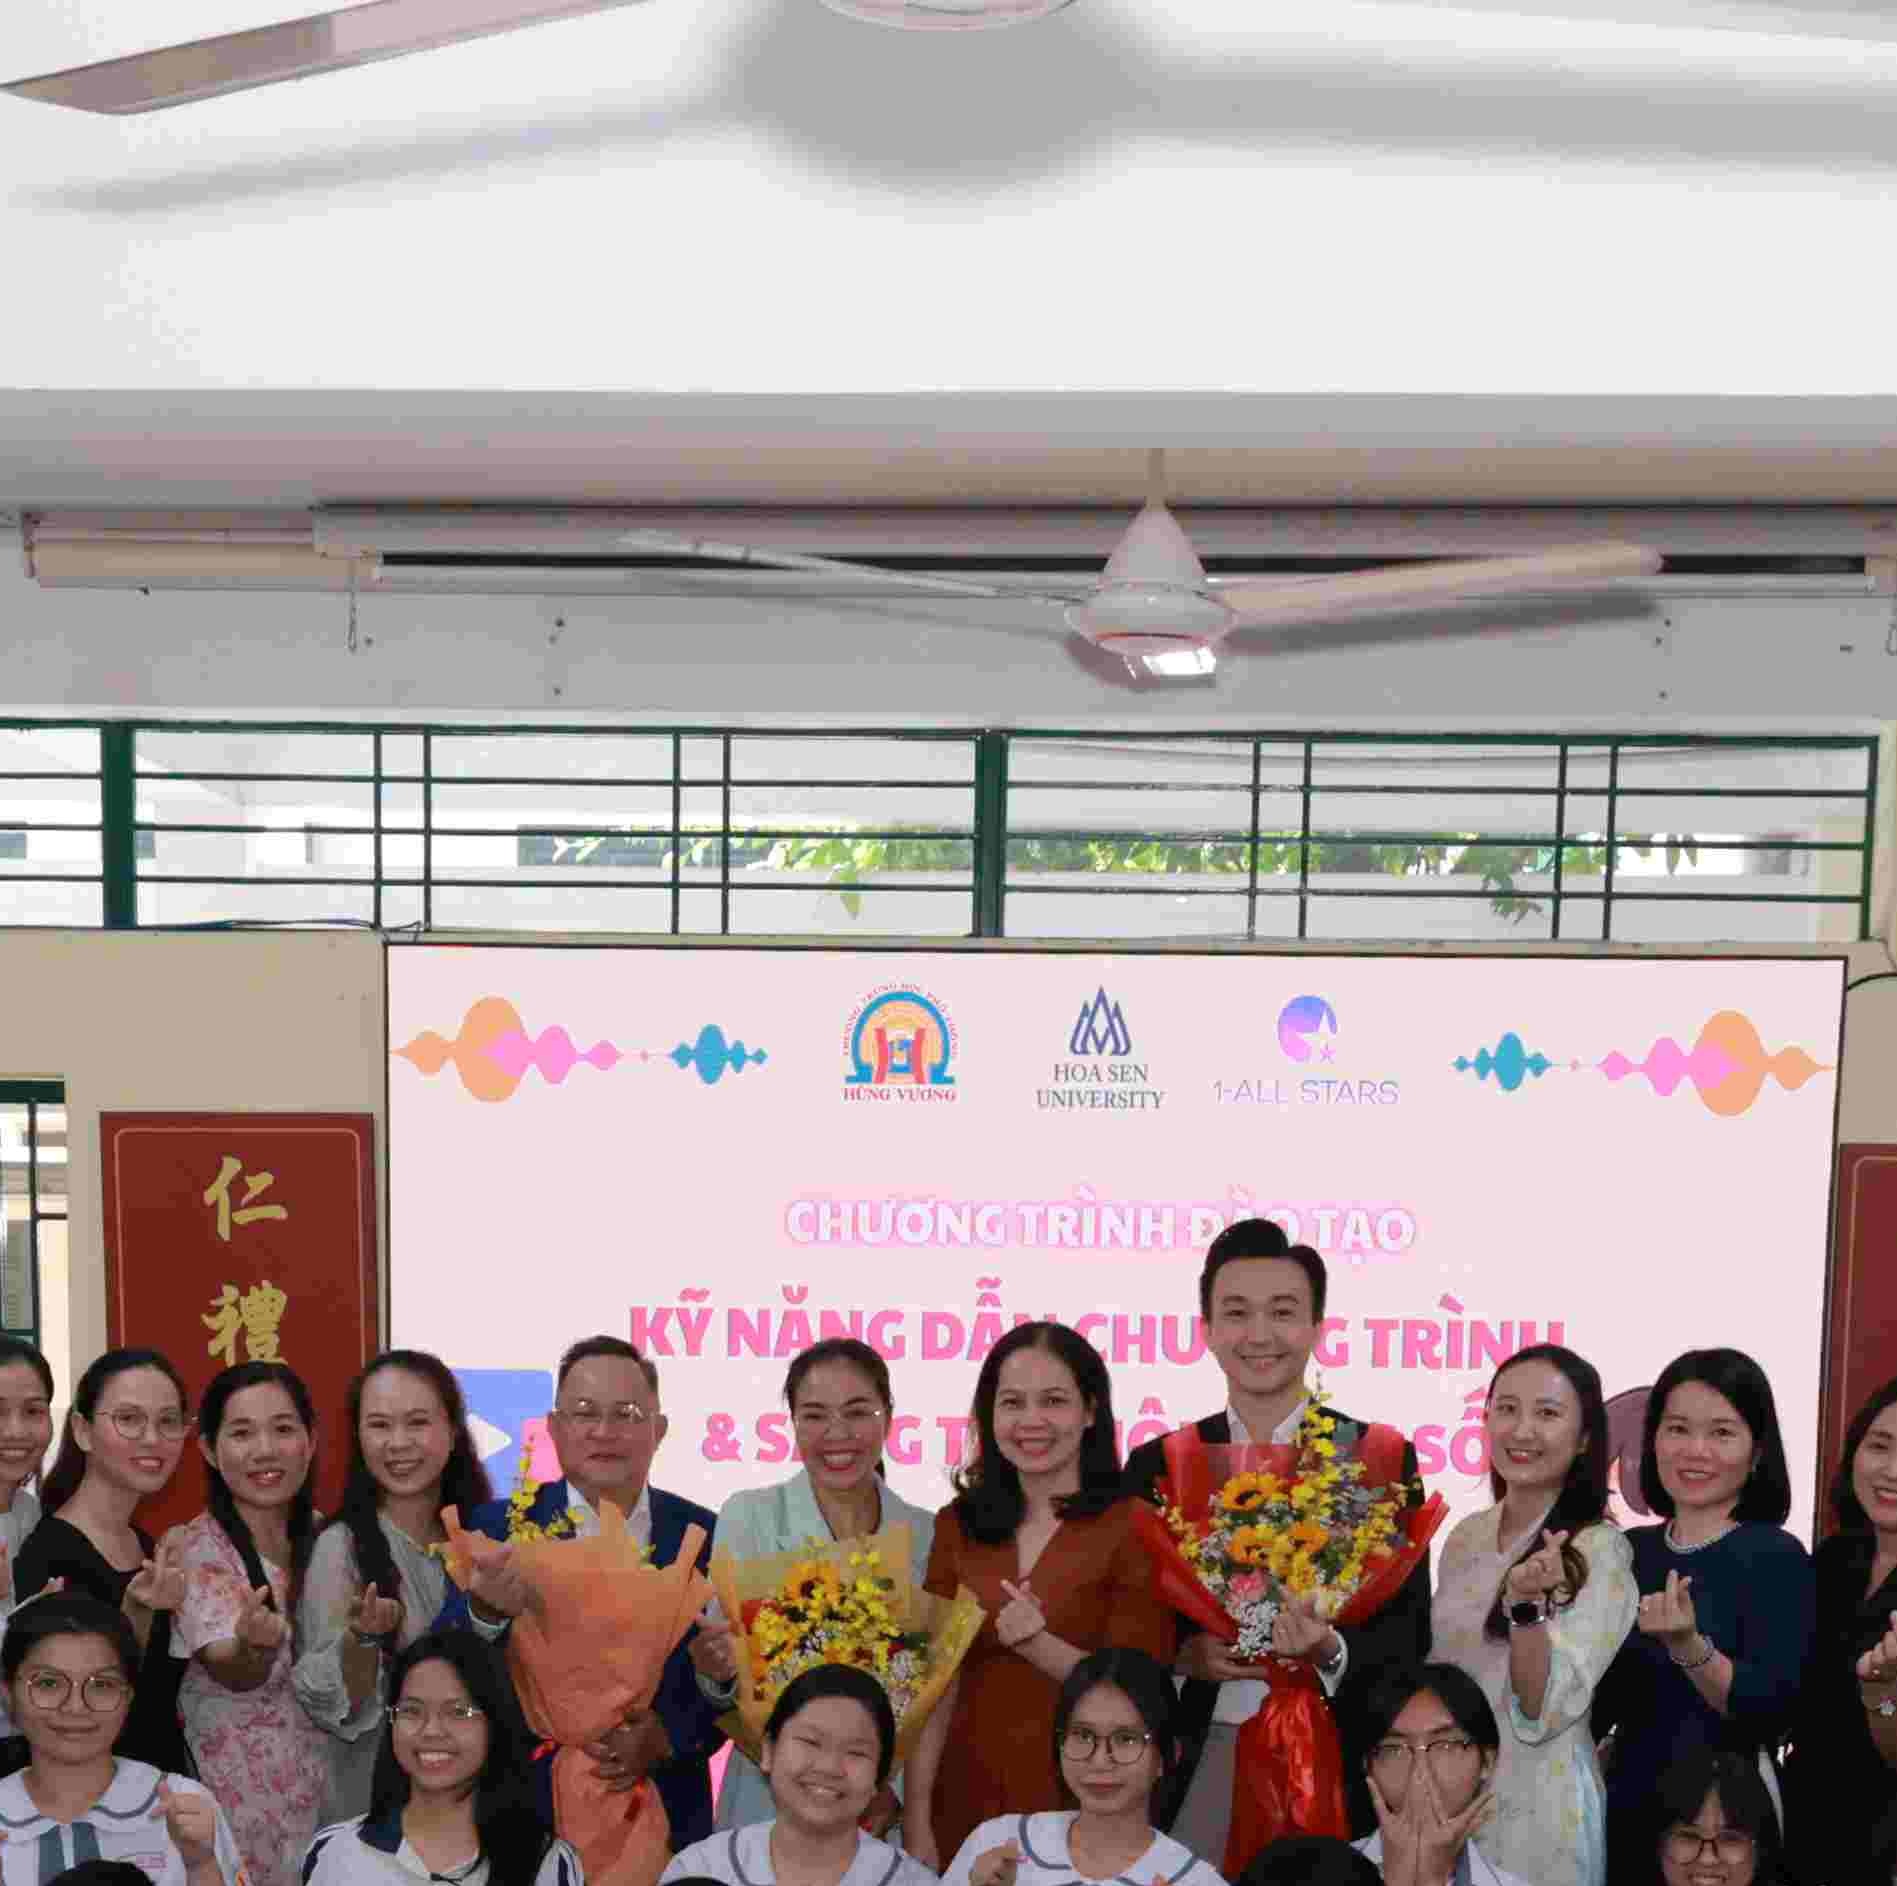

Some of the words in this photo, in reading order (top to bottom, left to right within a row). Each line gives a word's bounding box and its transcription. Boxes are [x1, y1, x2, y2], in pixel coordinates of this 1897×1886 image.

[1053, 1063, 1101, 1082] HOA
[1107, 1063, 1149, 1082] SEN
[1036, 1089, 1165, 1109] UNIVERSITY
[1300, 1080, 1399, 1106] STARS
[786, 1196, 1008, 1246] CHƯƠNG
[1015, 1183, 1174, 1250] TRÌNH
[1311, 1206, 1416, 1265] TẠO
[630, 1287, 713, 1358] KỸ
[702, 1412, 742, 1463] &
[754, 1413, 922, 1465] SG
